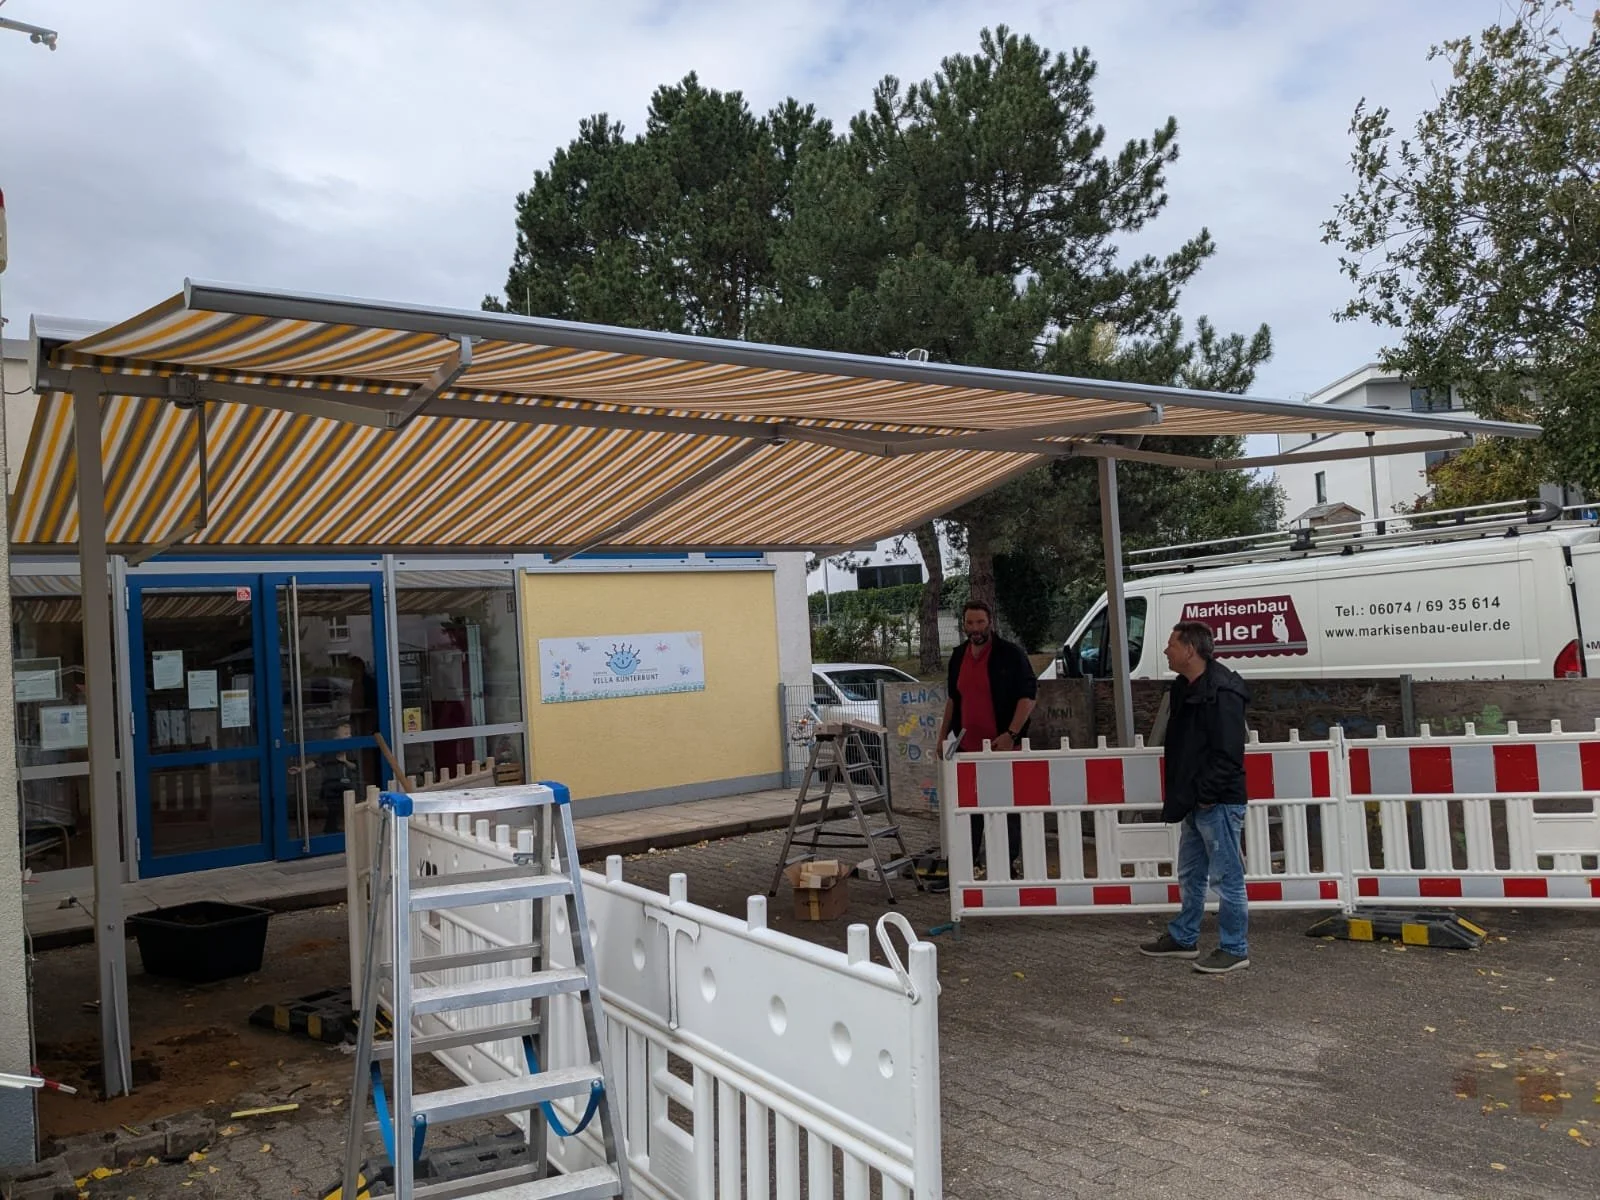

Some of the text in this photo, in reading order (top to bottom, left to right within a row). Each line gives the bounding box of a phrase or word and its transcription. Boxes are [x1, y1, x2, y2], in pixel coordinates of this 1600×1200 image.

[1186, 599, 1288, 618] Markisenbau
[1335, 605, 1364, 616] Tel.:
[1369, 602, 1411, 615] 06074
[1426, 600, 1443, 612] 69
[1449, 598, 1467, 610] 35
[1472, 596, 1500, 609] 614
[1213, 621, 1263, 641] uler
[1325, 618, 1511, 638] www.markisenbau-euler.de
[616, 673, 659, 682] KUNTERBUNT
